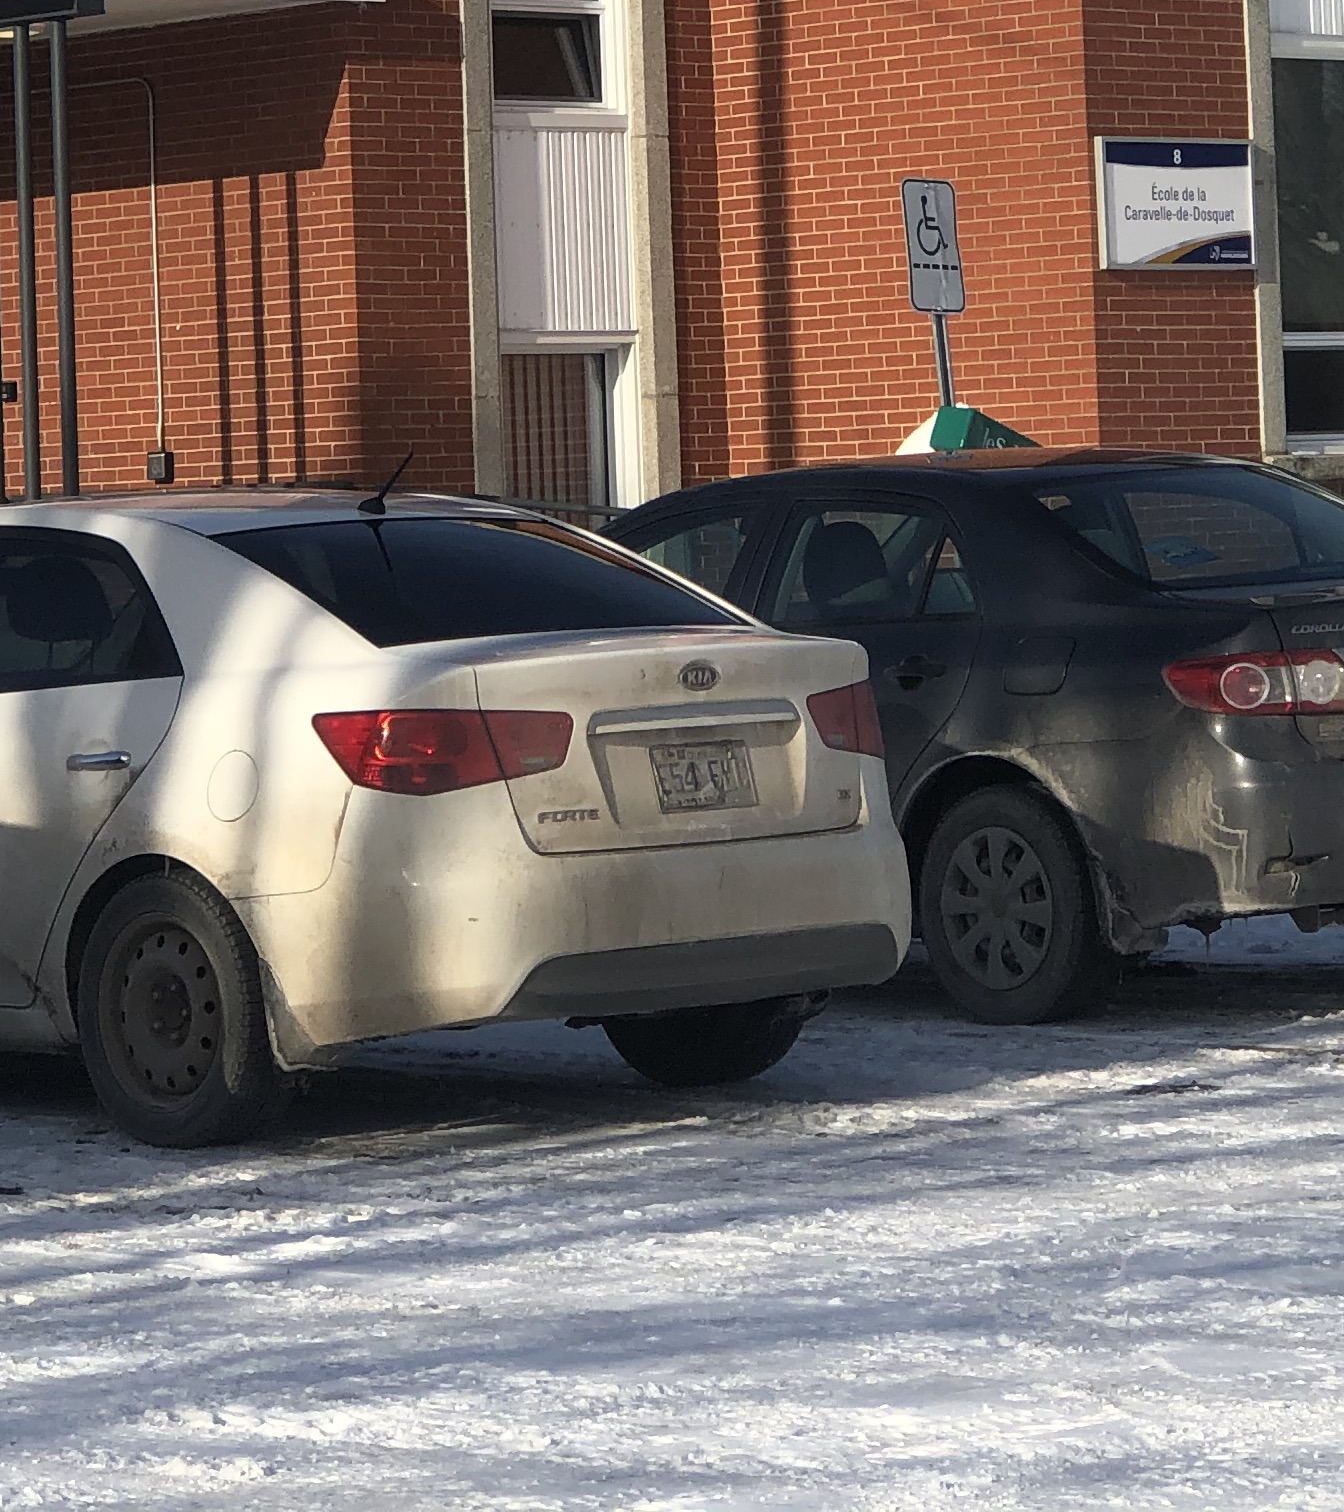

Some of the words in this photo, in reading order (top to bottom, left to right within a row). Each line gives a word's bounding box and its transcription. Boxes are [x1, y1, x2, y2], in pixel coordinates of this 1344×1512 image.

[1173, 149, 1182, 165] 8
[1151, 182, 1179, 201] École
[1182, 187, 1195, 201] de
[1197, 187, 1206, 201] la
[1124, 205, 1235, 224] Caravelle-de-Dosquet
[687, 669, 712, 686] KIA
[537, 808, 600, 824] FORTE
